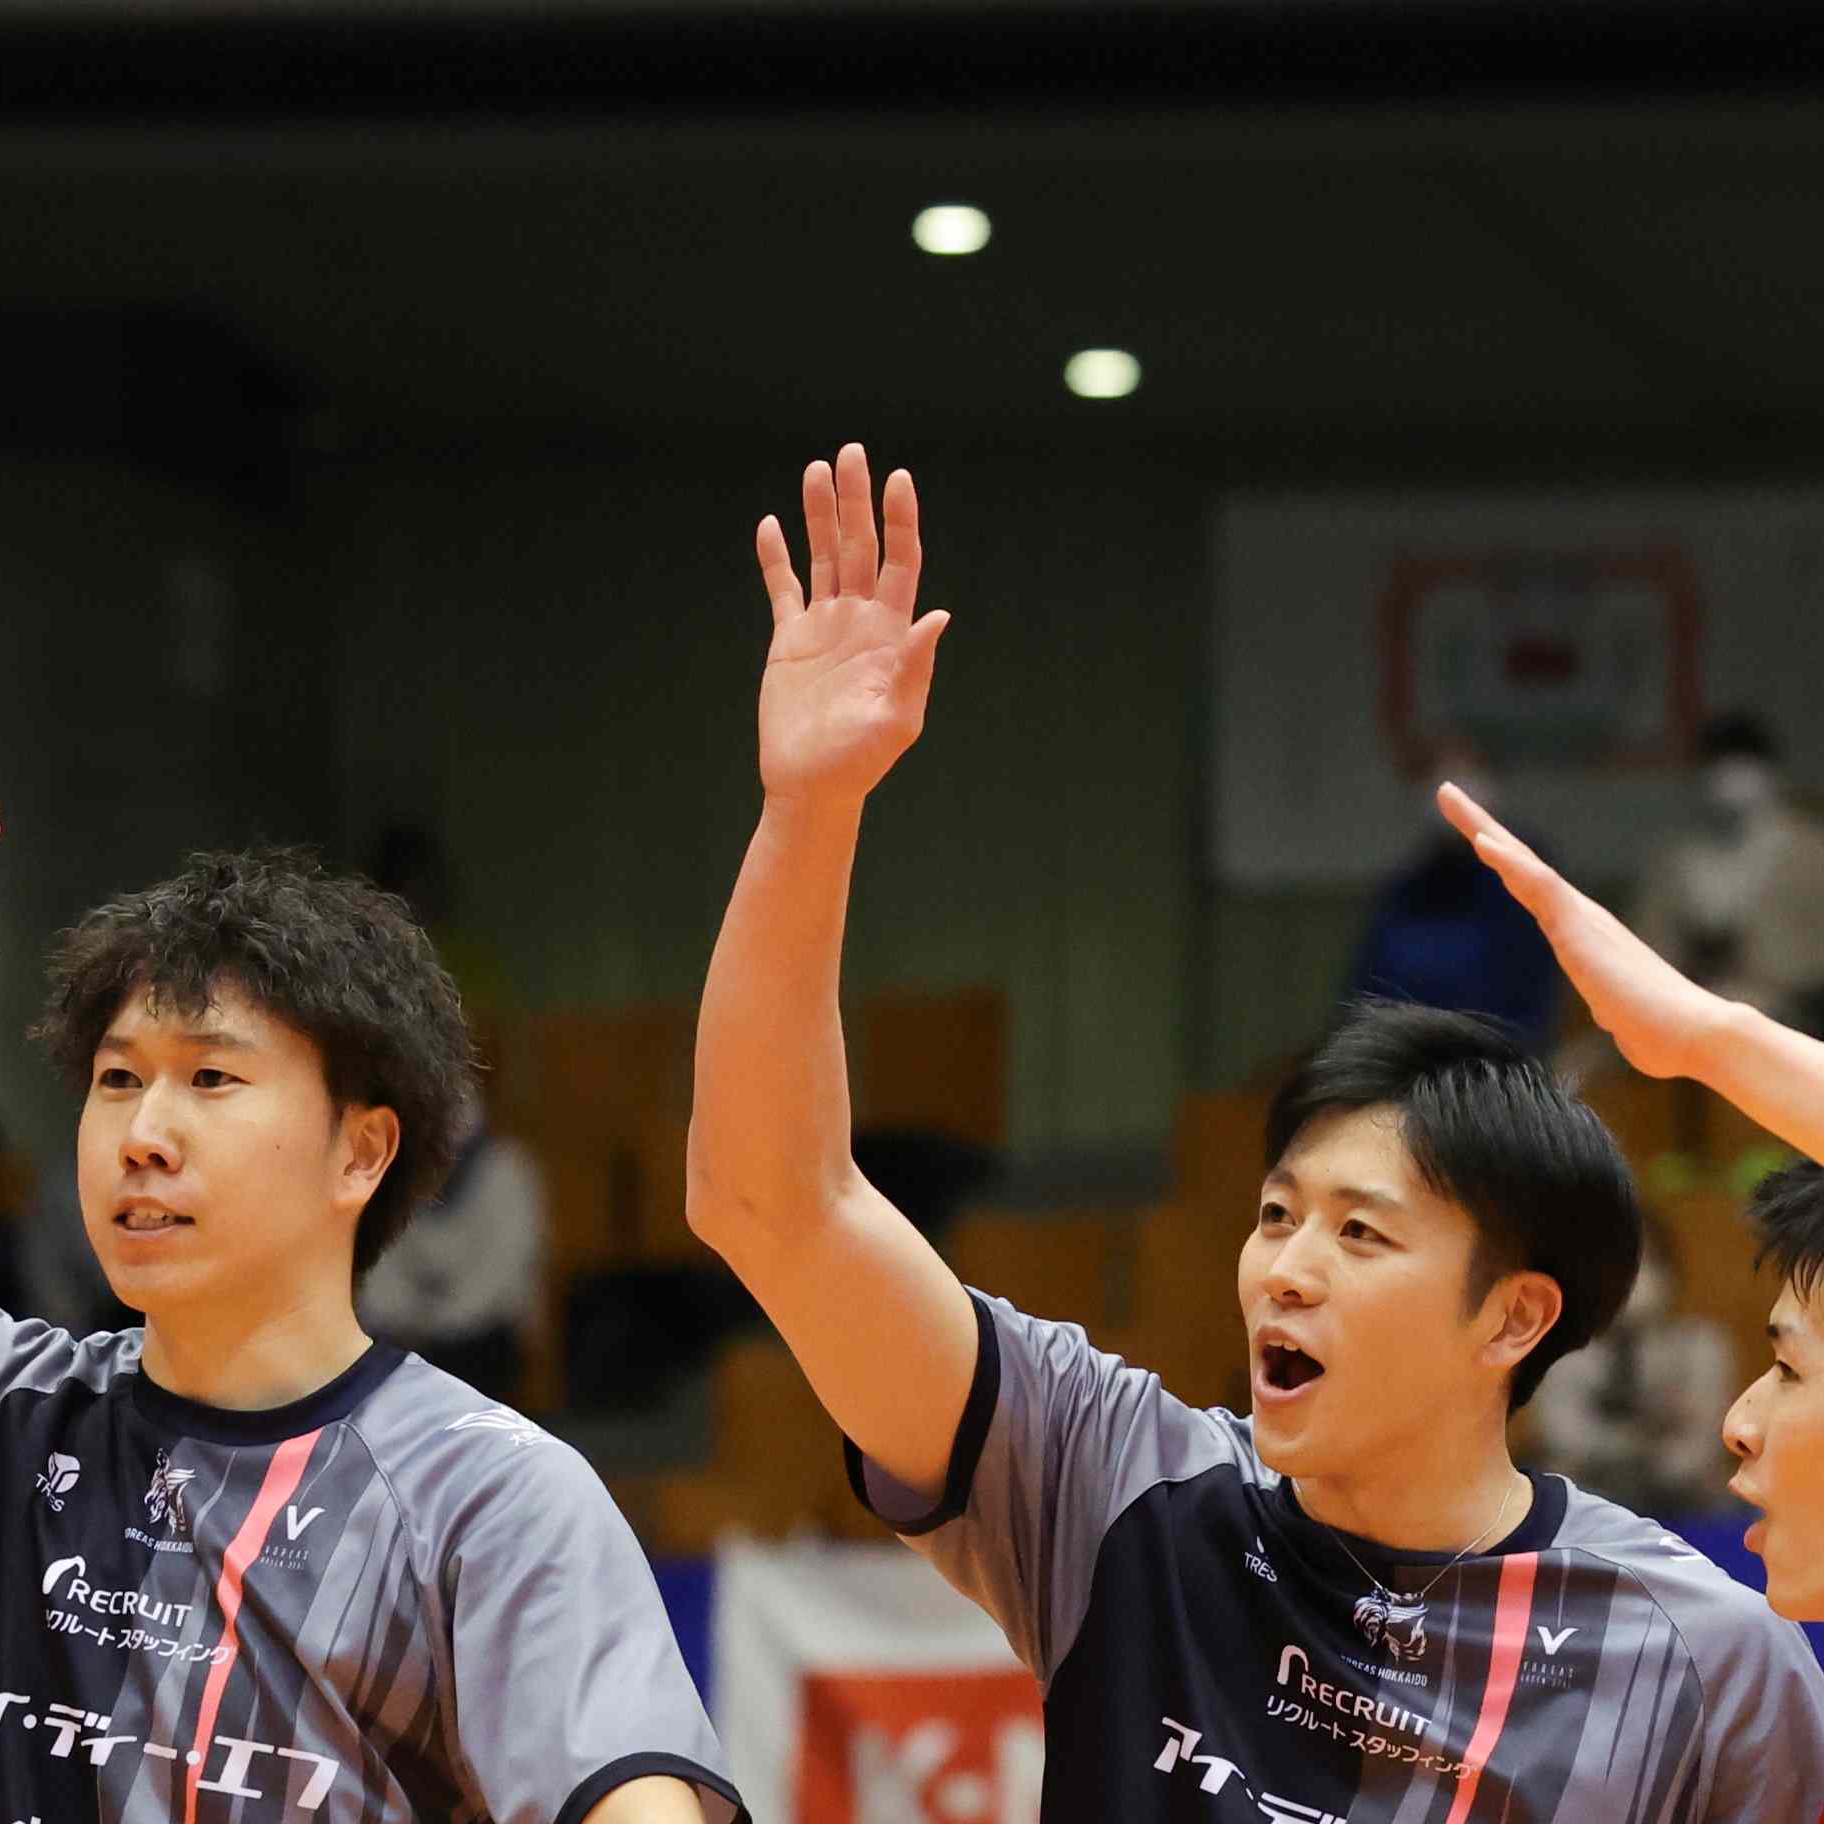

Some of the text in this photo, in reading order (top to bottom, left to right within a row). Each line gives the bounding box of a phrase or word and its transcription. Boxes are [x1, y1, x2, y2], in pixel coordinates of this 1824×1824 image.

[36, 1473, 66, 1513] TRS
[1244, 1551, 1277, 1582] TRES
[66, 1578, 193, 1628] RECRUIT
[1377, 1667, 1428, 1687] HOKKAIDO
[1301, 1673, 1433, 1736] RECRUIT
